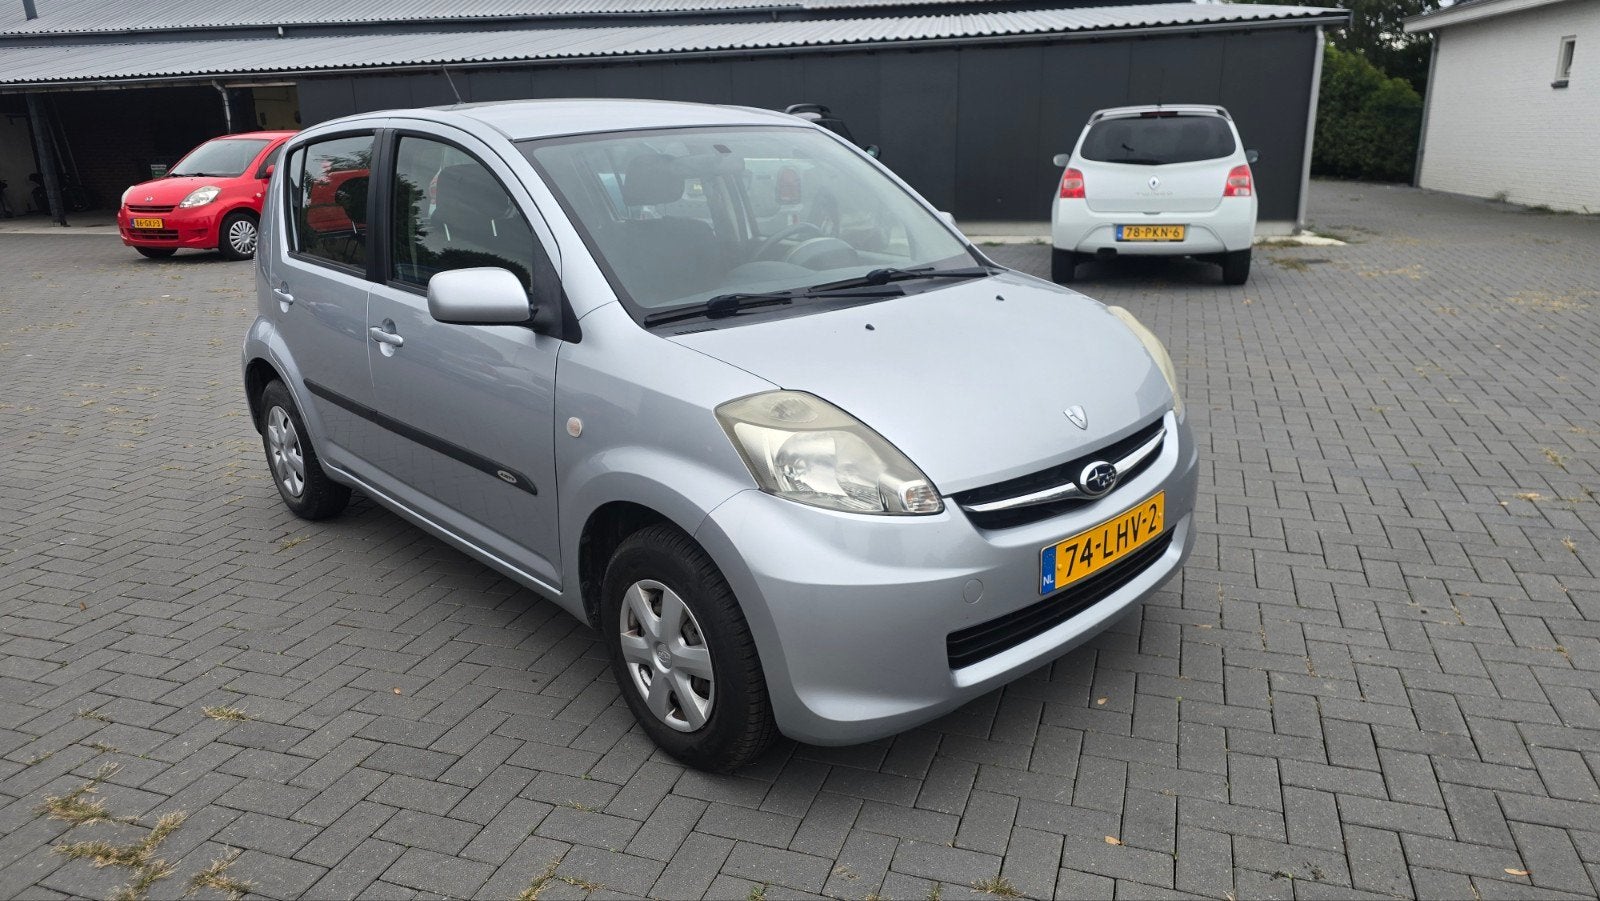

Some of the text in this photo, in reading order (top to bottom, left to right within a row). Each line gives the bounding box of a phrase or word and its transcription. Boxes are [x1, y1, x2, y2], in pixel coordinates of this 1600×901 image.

[1126, 227, 1180, 238] 78-PKN-6
[1065, 503, 1157, 578] 74-LHV-2
[1043, 574, 1055, 586] NL
